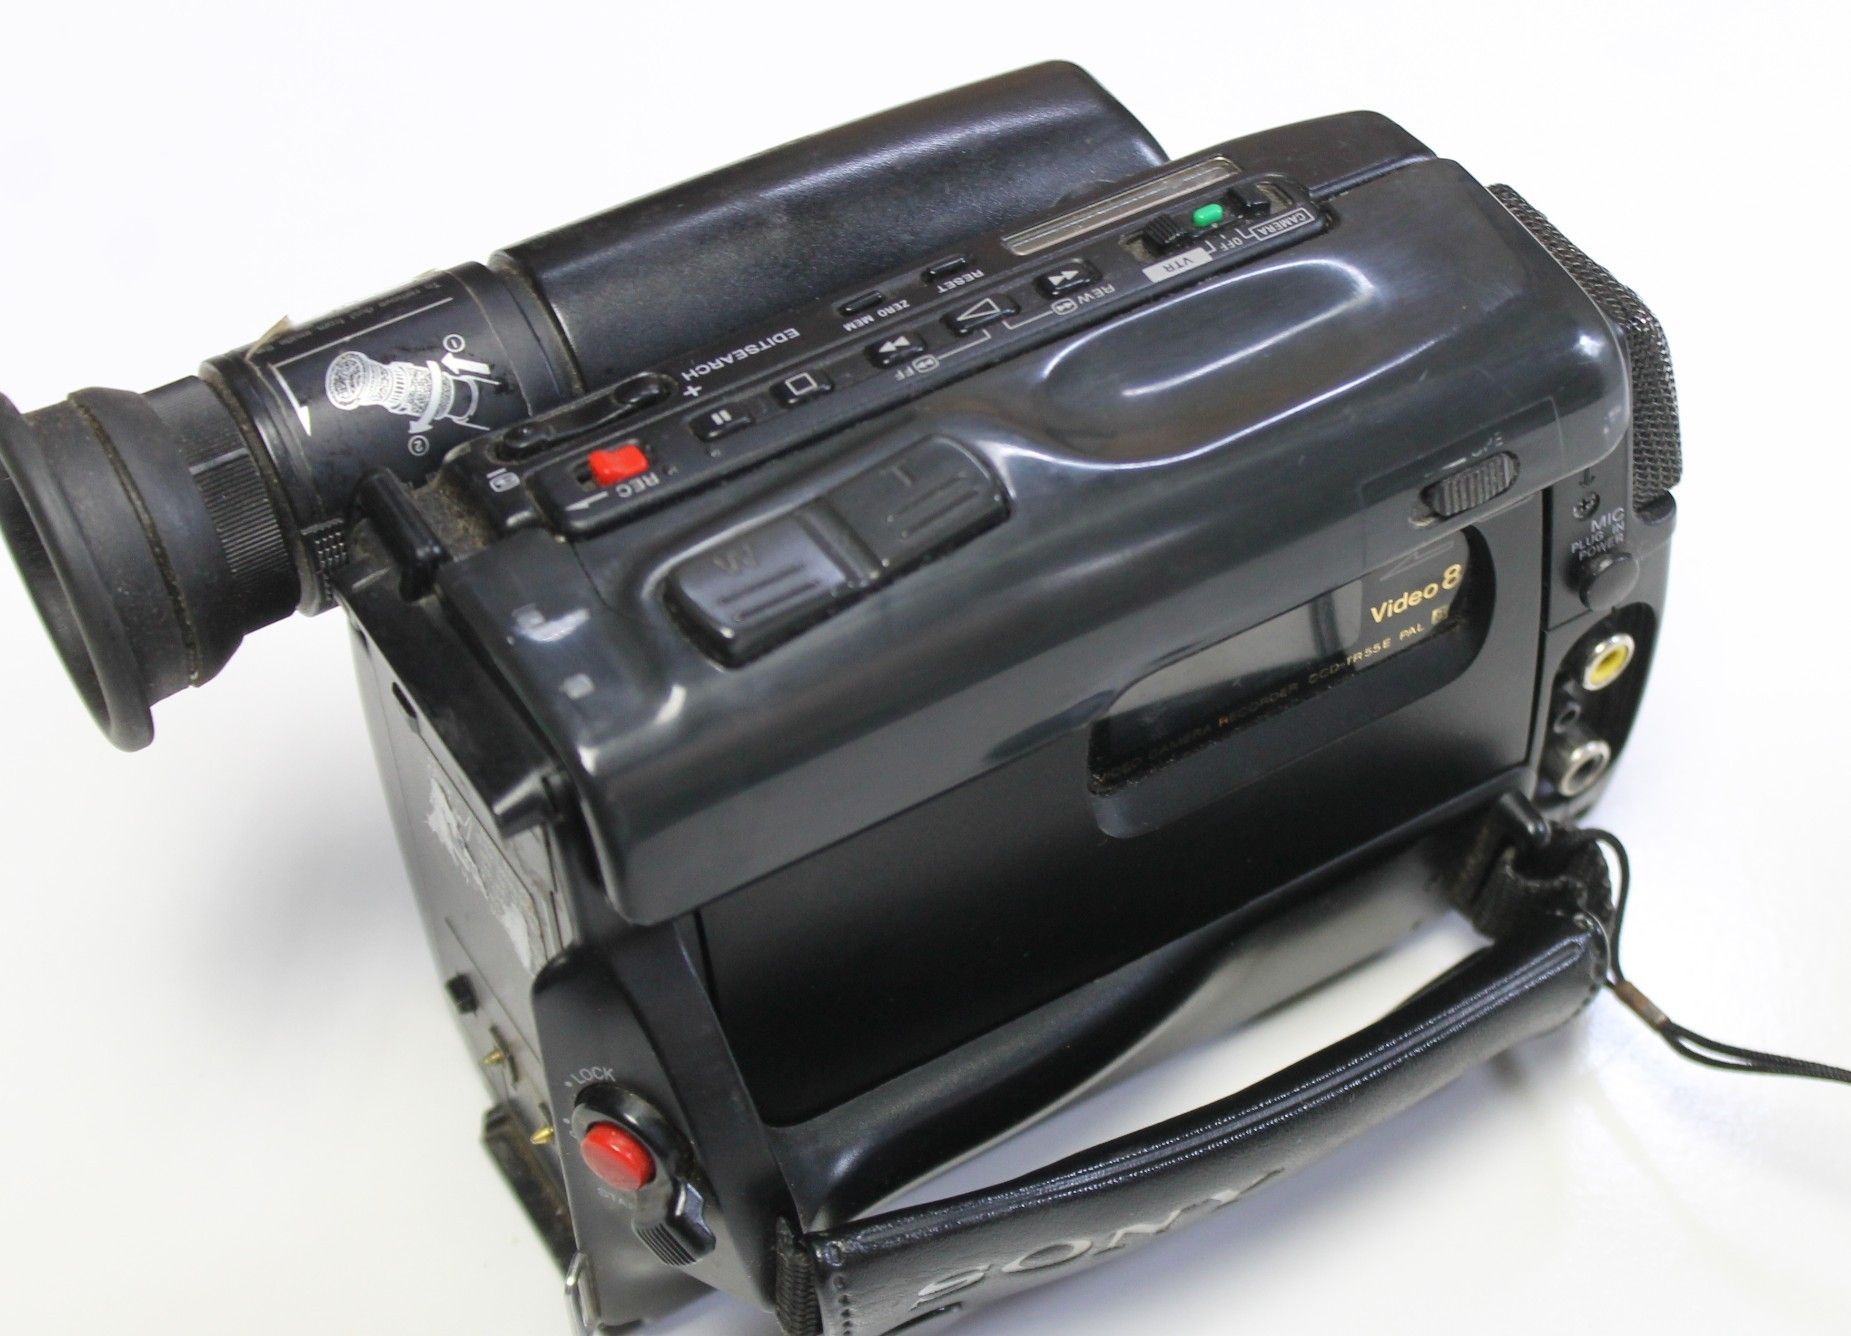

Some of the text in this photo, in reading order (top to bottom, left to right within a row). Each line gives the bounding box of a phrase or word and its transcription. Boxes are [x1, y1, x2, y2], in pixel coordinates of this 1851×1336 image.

[1257, 211, 1308, 236] CAMERA
[1219, 236, 1243, 251] OFF
[1163, 256, 1194, 273] VTR
[936, 268, 985, 294] RESET
[1077, 283, 1116, 305] REW
[842, 299, 911, 332] ZERO MEM
[681, 327, 801, 382] EDITSEARCH
[894, 366, 916, 381] FF
[615, 471, 660, 498] REC
[1591, 507, 1625, 532] MIC
[1571, 530, 1605, 554] PLUG
[1399, 622, 1426, 641] PAL
[570, 1066, 616, 1086] LOCK
[909, 1167, 1286, 1312] SONY
